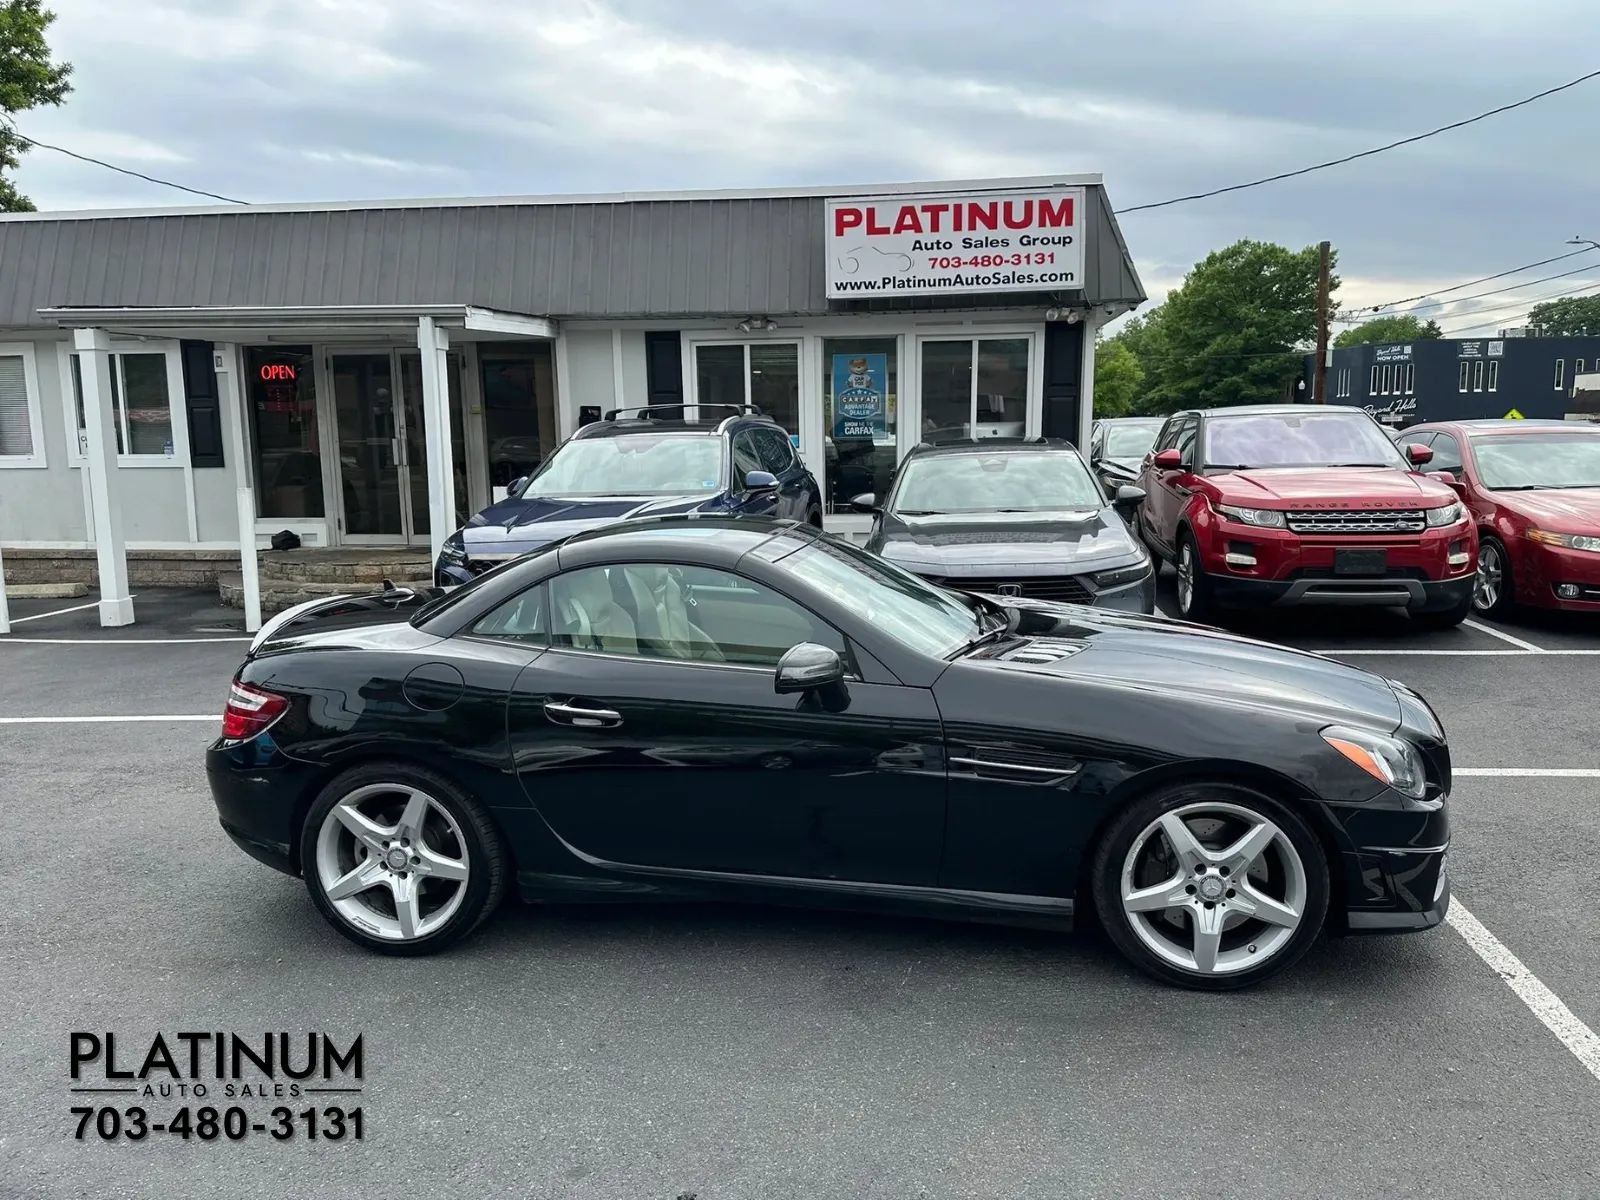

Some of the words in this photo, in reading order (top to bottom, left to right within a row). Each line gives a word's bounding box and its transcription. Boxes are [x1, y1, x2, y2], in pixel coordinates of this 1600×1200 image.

[835, 198, 1074, 237] PLATINUM
[912, 240, 953, 252] Auto
[962, 237, 1010, 249] Sales
[1019, 235, 1073, 249] Group
[928, 252, 1056, 270] 703-480-3131
[835, 271, 1074, 292] www.PlatinumAutoSales.com
[261, 365, 295, 380] OPEN
[844, 427, 874, 435] CARFAX
